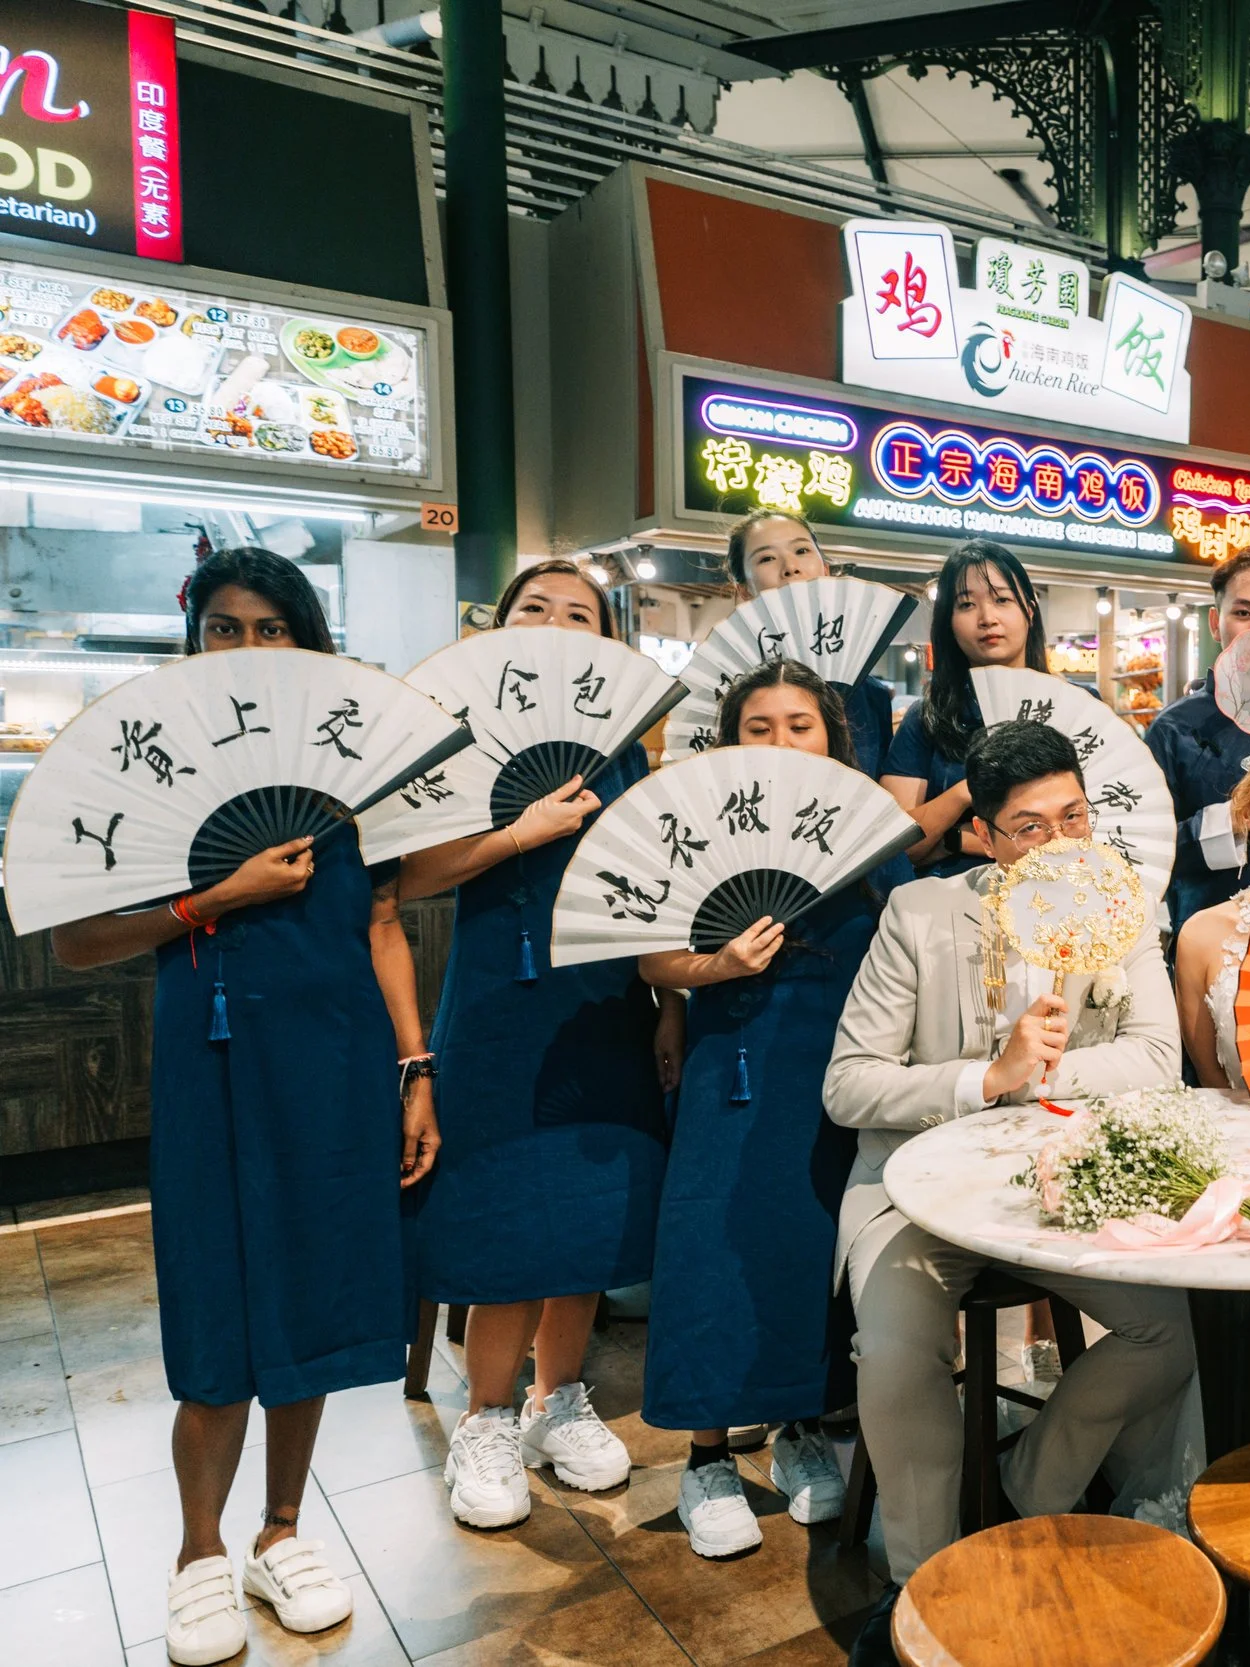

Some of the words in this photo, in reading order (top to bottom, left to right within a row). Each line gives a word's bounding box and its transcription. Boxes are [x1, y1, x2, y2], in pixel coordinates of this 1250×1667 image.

[875, 250, 943, 338] 鸡
[209, 308, 227, 321] 12
[1112, 312, 1166, 392] 饭
[375, 384, 392, 395] 14
[1066, 372, 1100, 397] Rice
[168, 400, 185, 413] 13
[708, 404, 774, 431] LEMON
[775, 414, 849, 443] CHICKEN
[702, 437, 852, 510] 柠檬鸡
[888, 441, 1145, 512] 正宗海南鸡饭
[1173, 469, 1232, 497] Chicken
[426, 509, 455, 526] 20
[854, 498, 963, 529] AUTHENTIC
[964, 510, 1065, 541] HAINANESE
[1066, 523, 1138, 549] CHICKEN
[1138, 532, 1175, 555] RICE
